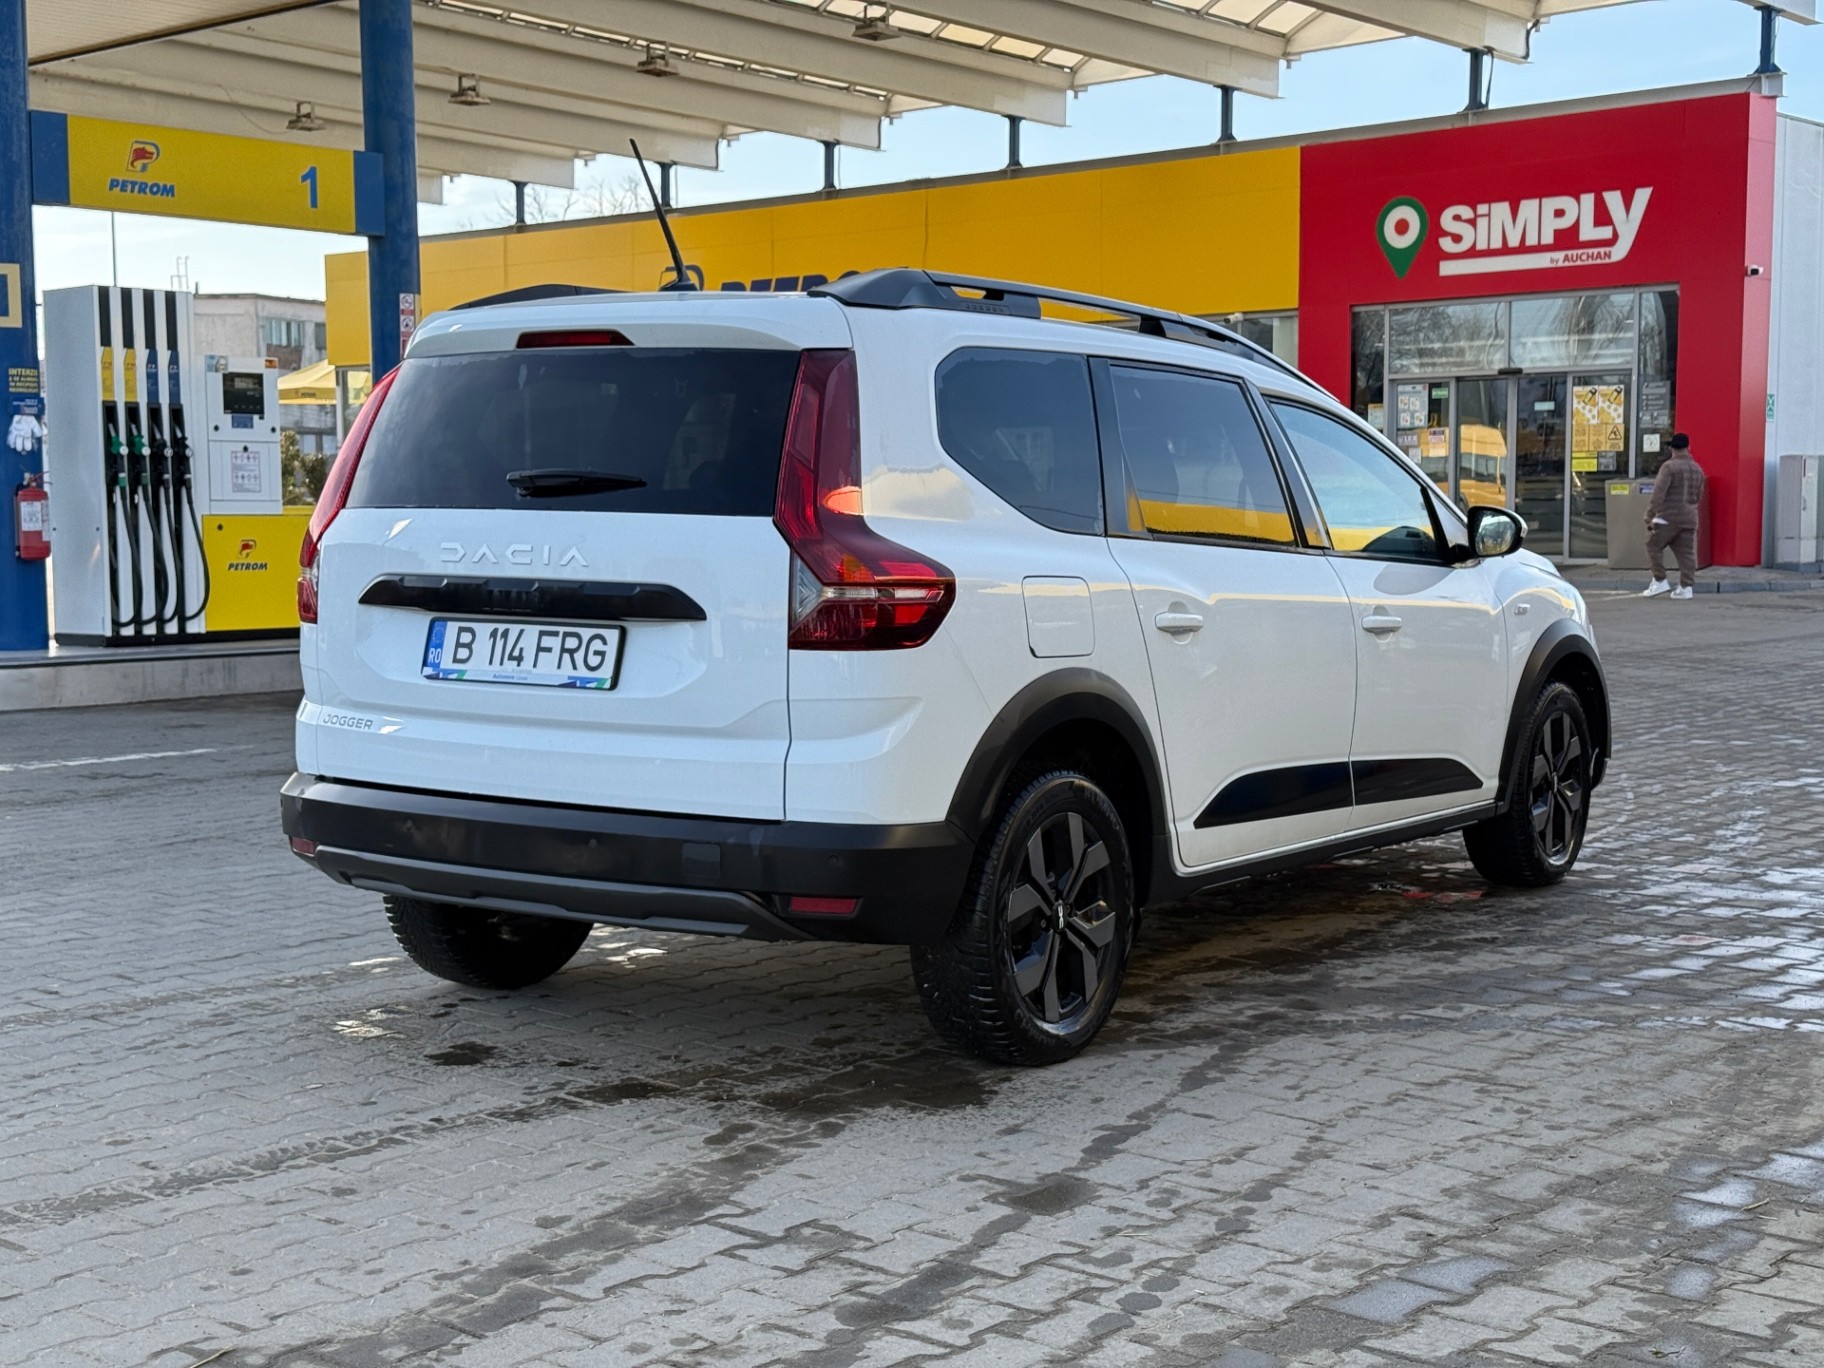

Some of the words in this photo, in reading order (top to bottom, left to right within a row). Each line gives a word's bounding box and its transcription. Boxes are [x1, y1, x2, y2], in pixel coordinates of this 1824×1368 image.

[108, 178, 175, 198] PETROM
[300, 166, 318, 208] 1
[1550, 257, 1559, 266] by
[1562, 250, 1612, 264] AUCHAN
[440, 542, 589, 567] DACIA
[228, 562, 268, 571] PETROM
[427, 648, 442, 663] RO
[452, 626, 476, 664] B
[488, 627, 526, 667] 114
[533, 630, 608, 672] FRG
[323, 714, 374, 730] JOGGER
